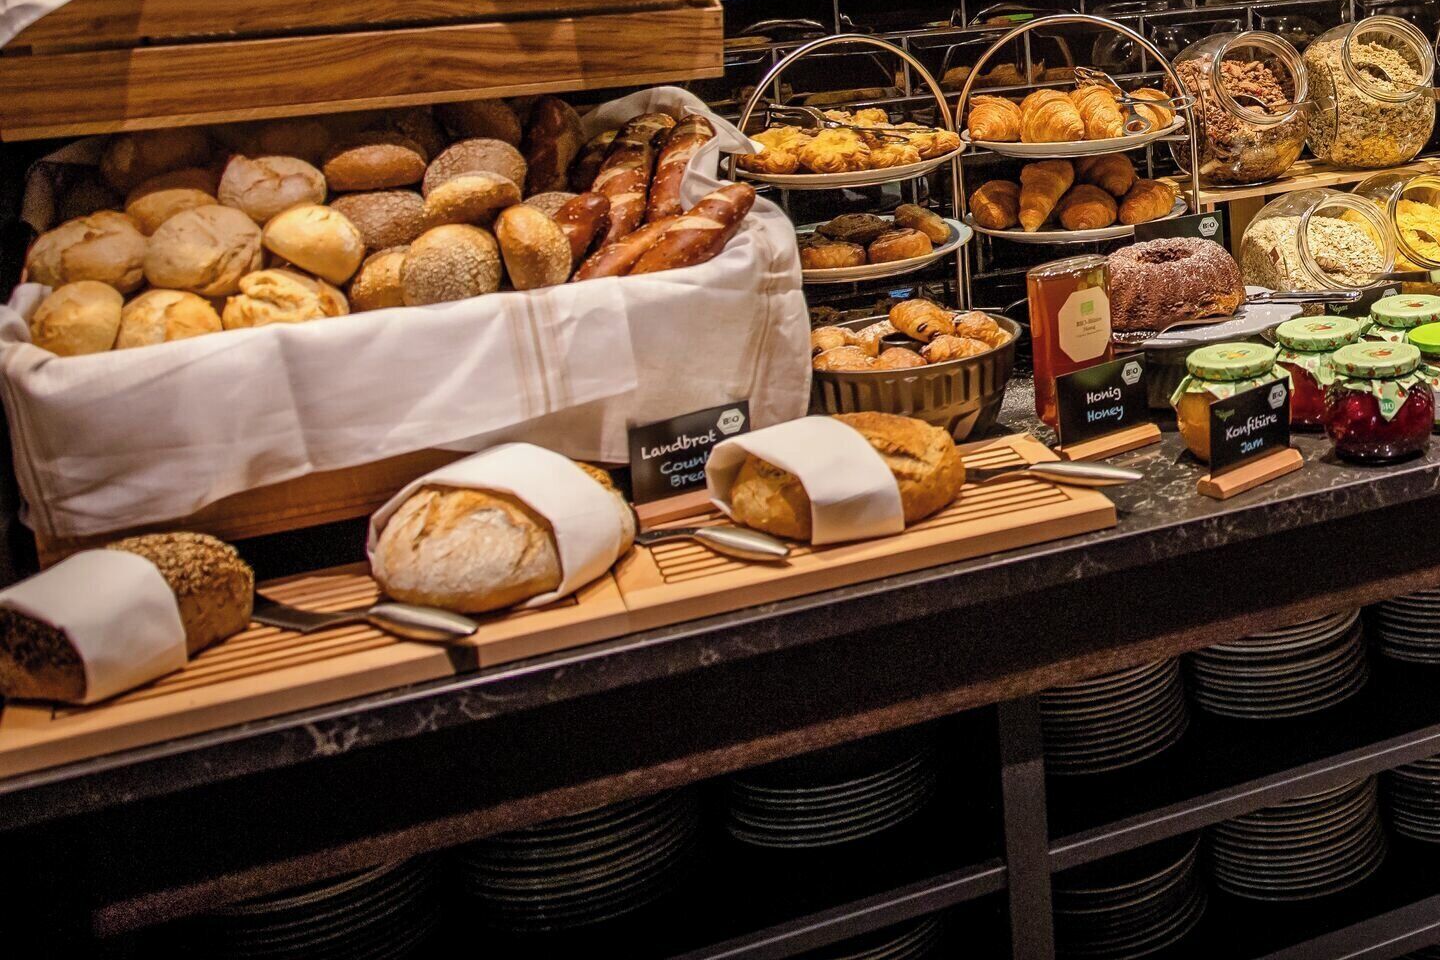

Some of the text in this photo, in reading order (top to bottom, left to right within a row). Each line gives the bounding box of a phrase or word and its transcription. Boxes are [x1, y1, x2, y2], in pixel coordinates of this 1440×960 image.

[1086, 386, 1121, 404] Honig
[722, 415, 740, 426] BIO
[1087, 405, 1124, 422] Honey
[1225, 413, 1278, 441] Konfitüre
[641, 429, 717, 460] Landbrot
[1240, 437, 1264, 454] Jam
[670, 470, 707, 488] Brea
